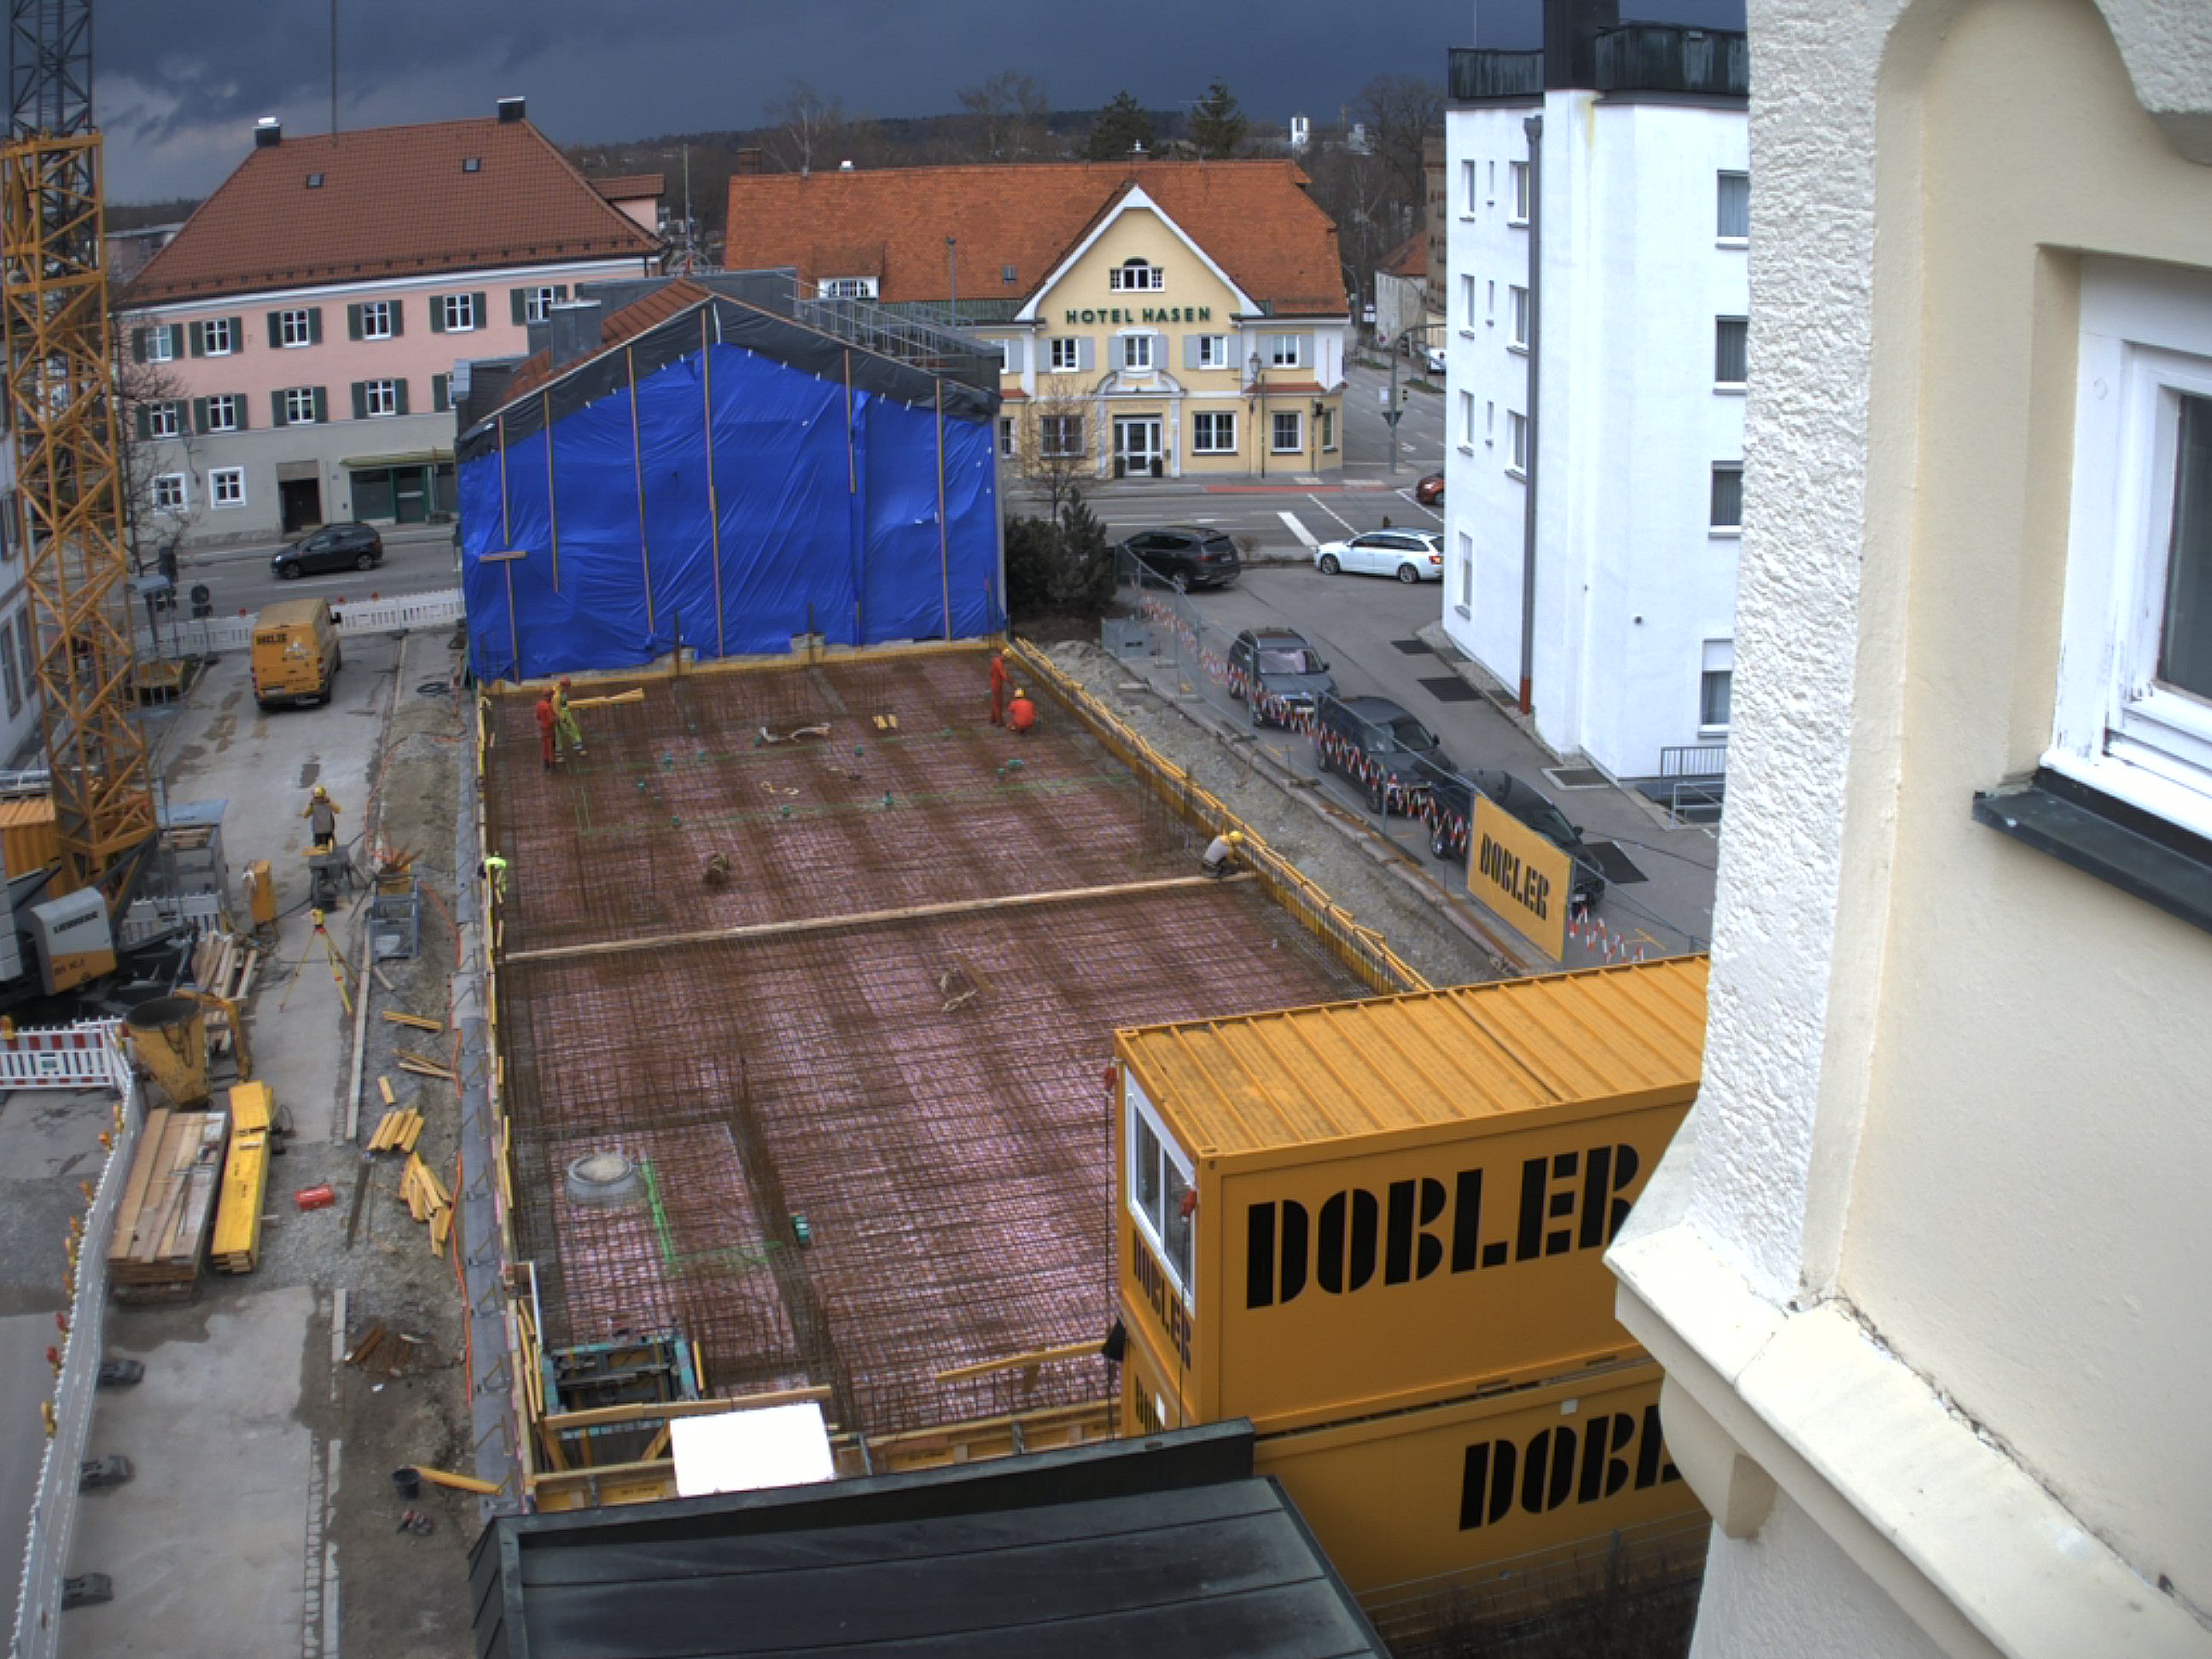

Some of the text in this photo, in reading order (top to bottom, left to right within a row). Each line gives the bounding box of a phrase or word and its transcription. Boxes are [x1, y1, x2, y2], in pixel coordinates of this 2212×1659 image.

[1066, 306, 1211, 324] HOTEL HASEN
[1481, 832, 1550, 921] DOBLER
[1247, 1144, 1639, 1310] DOBLER
[1133, 1227, 1191, 1372] DOBLER
